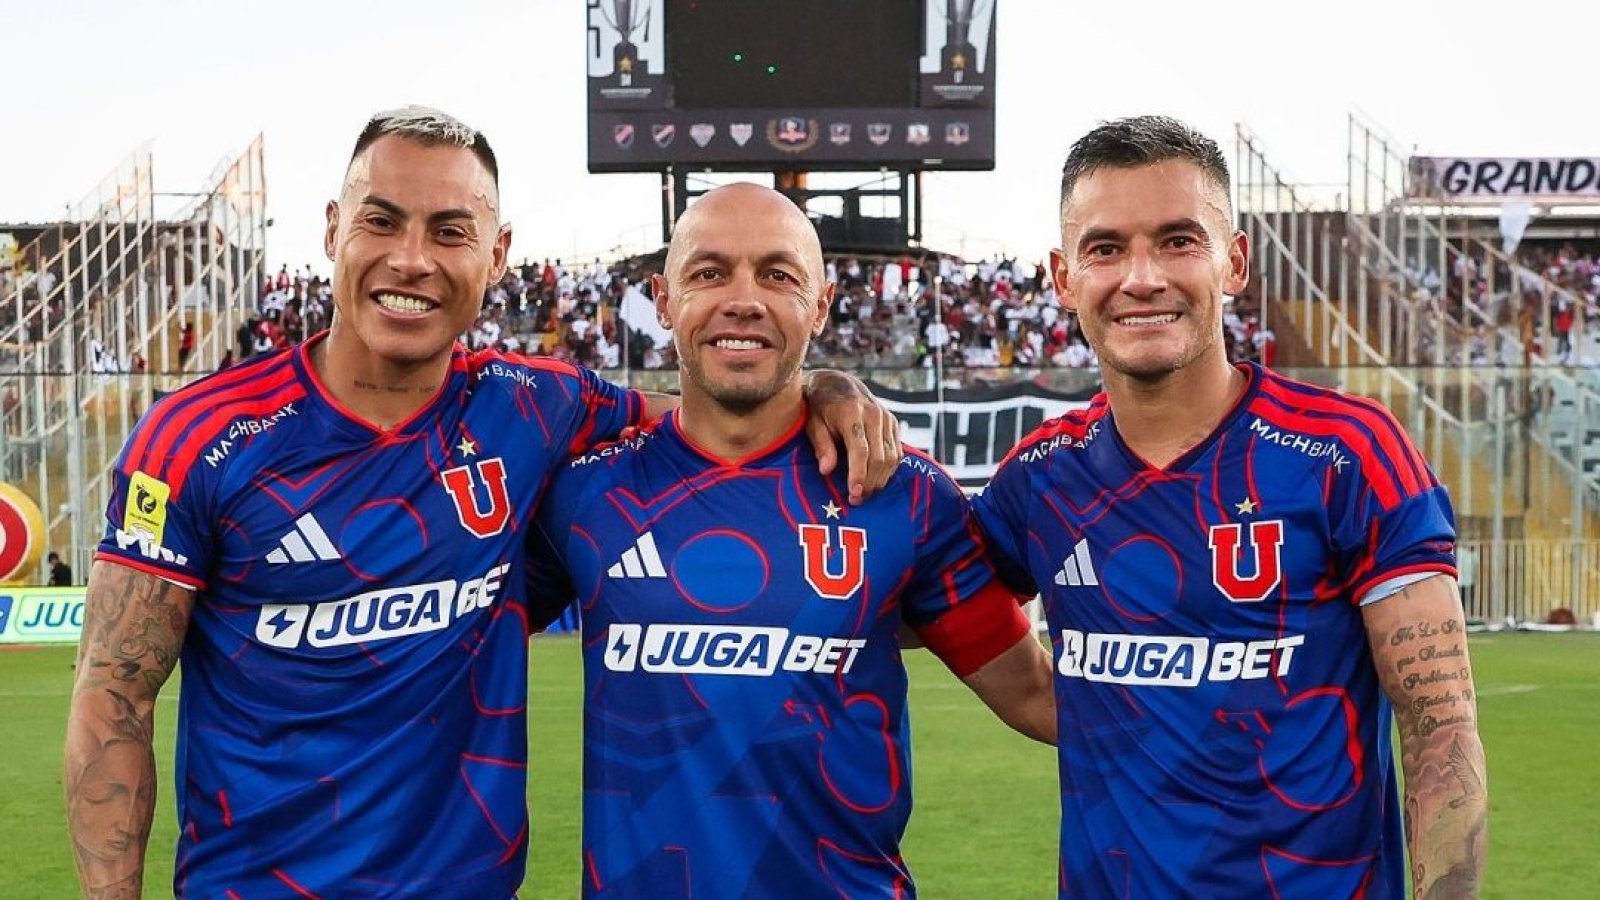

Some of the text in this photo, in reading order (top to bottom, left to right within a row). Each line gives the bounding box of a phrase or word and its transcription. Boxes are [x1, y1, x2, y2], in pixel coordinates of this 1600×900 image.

[1442, 159, 1600, 195] GRAND
[204, 403, 298, 468] MACHBANK
[456, 563, 511, 618] BE
[23, 603, 85, 627] JUG
